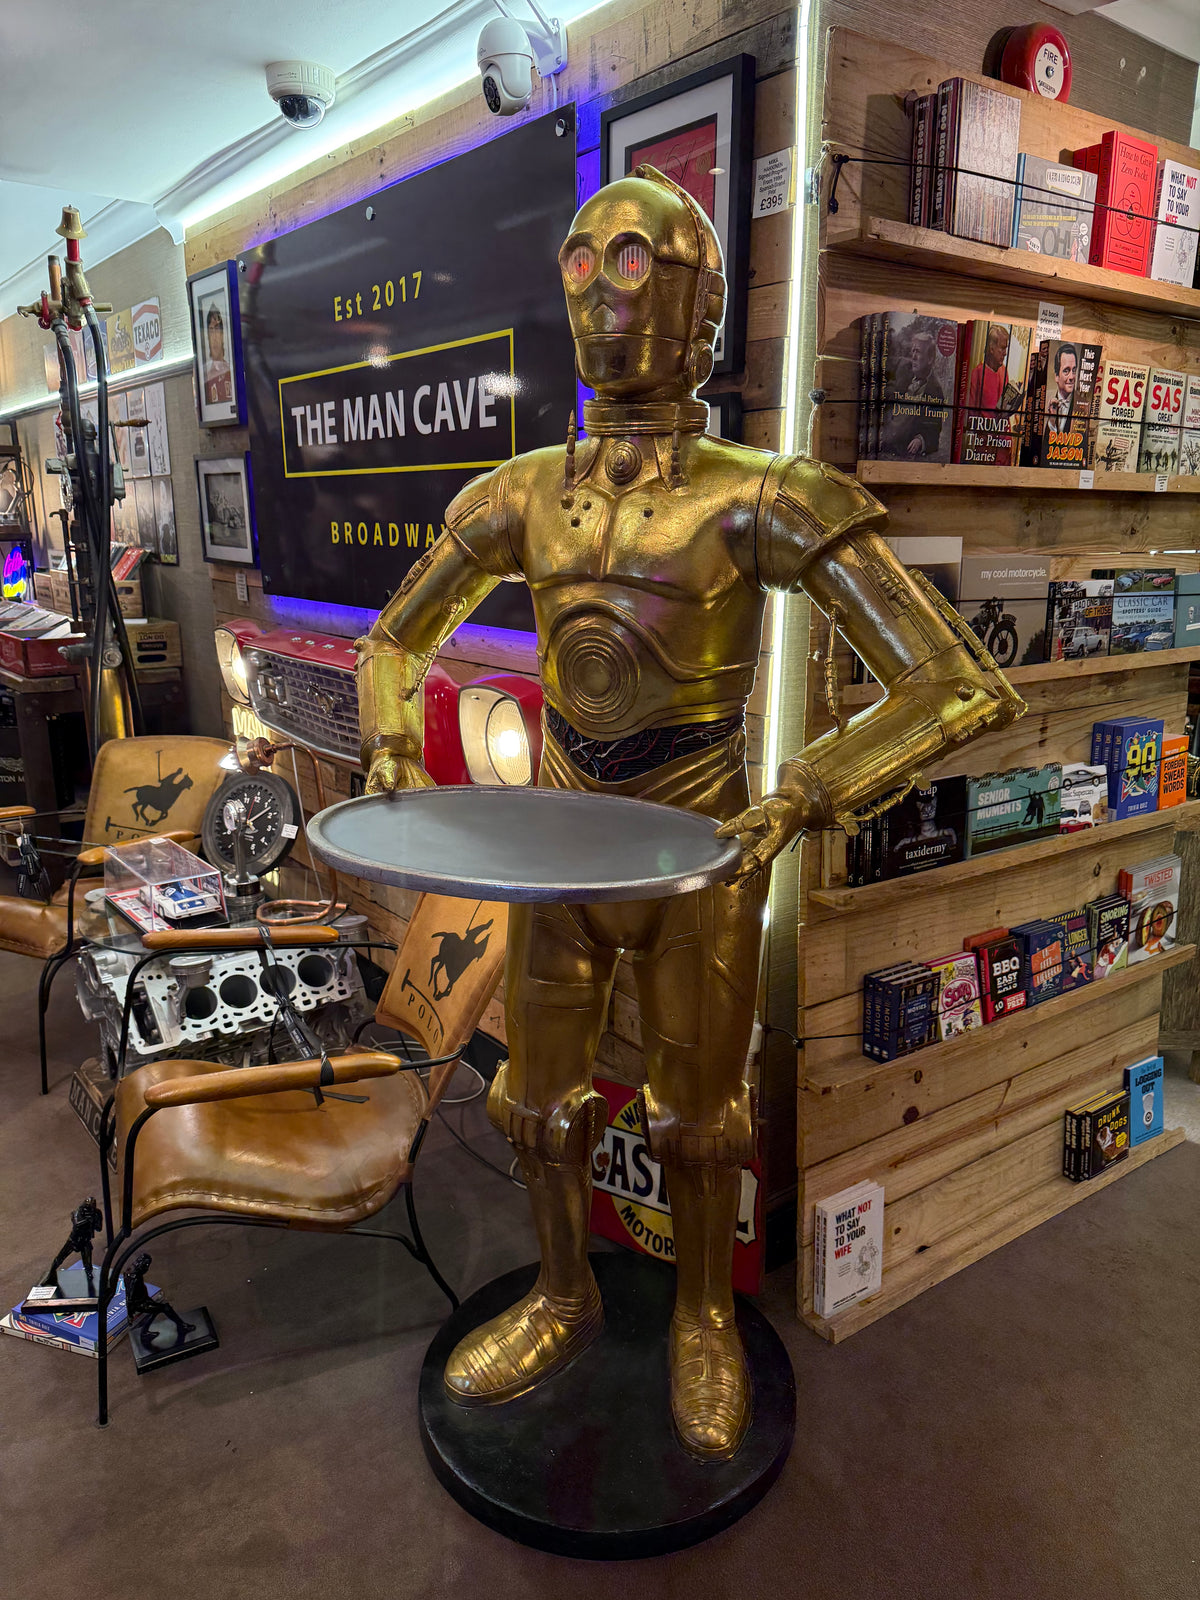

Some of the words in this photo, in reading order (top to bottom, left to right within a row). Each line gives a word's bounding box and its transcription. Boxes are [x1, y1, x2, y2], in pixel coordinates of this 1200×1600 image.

[1043, 48, 1058, 65] FIRE
[1120, 146, 1133, 160] How
[1133, 151, 1139, 161] to
[1121, 162, 1134, 176] Zero
[1170, 170, 1186, 186] WHAT
[1185, 174, 1198, 190] NOT
[936, 173, 944, 210] COVERS
[1169, 185, 1176, 198] TO
[1176, 186, 1187, 202] SAY
[760, 194, 783, 211] £395
[912, 188, 922, 225] COVERS
[1167, 199, 1174, 212] TO
[1175, 201, 1190, 217] YOUR
[334, 292, 362, 322] Est
[372, 270, 422, 311] 2017
[134, 318, 160, 345] TEXACO
[1084, 348, 1096, 360] This
[1080, 358, 1095, 371] Time
[1080, 370, 1093, 382] Next
[1109, 367, 1130, 378] Damien
[1131, 370, 1146, 380] Lewis
[1152, 374, 1171, 384] Damien
[1172, 378, 1184, 387] Lewis
[1079, 382, 1091, 393] Year
[1105, 377, 1144, 408] SAS
[892, 392, 903, 400] The
[904, 393, 927, 402] Beautiful
[927, 395, 943, 404] Poetry
[1150, 384, 1182, 413] SAS
[291, 401, 338, 447] THE
[343, 390, 406, 442] MAN
[413, 375, 497, 435] CAVE
[892, 404, 921, 416] Donald
[922, 406, 949, 422] Trump
[1111, 406, 1134, 419] FORGED
[1158, 412, 1174, 422] GREAT
[968, 416, 1010, 432] TRUMP:
[1110, 418, 1117, 428] IN
[1117, 420, 1134, 430] HELL
[1147, 422, 1170, 434] ESCAPES
[966, 433, 984, 446] The
[986, 434, 1012, 448] Prison
[1048, 431, 1084, 447] DAVID
[966, 448, 996, 462] Diaries
[1046, 446, 1084, 462] JASON
[330, 521, 446, 548] BROADWA
[981, 570, 992, 580] my
[992, 568, 1008, 578] cool
[1008, 567, 1047, 578] motorcycle.
[1117, 598, 1150, 608] CLASSIC
[1152, 596, 1168, 606] CAR
[1085, 608, 1094, 617] OF
[1094, 606, 1112, 616] THOSE
[1164, 758, 1186, 772] FOREIGN
[1163, 768, 1185, 784] SWEAR
[1162, 780, 1185, 794] WORDS
[244, 796, 250, 804] 11
[977, 788, 1010, 806] SENIOR
[976, 800, 1022, 820] MOMENTS
[1127, 803, 1140, 812] TRIVIA
[260, 836, 266, 844] 4
[905, 842, 948, 860] taxidermy
[1144, 868, 1174, 887] TWISTED
[1100, 904, 1129, 924] SNORING
[1068, 928, 1088, 945] LONGER
[992, 956, 1020, 976] BBQ
[996, 972, 1018, 986] EASY
[907, 1003, 927, 1014] MOVIES
[994, 1001, 1004, 1012] 10
[1006, 998, 1025, 1010] PREP
[408, 993, 439, 1044] POLO
[864, 1000, 872, 1034] MOVIES
[1135, 1068, 1162, 1087] LOGGING
[1142, 1081, 1155, 1094] OUT
[1098, 1104, 1121, 1128] DRUNK
[1109, 1116, 1128, 1131] DOGS
[836, 1206, 856, 1224] WHAT
[857, 1200, 872, 1215] NOT
[835, 1225, 845, 1236] TO
[846, 1216, 860, 1231] SAY
[834, 1237, 844, 1248] TO
[846, 1226, 866, 1242] YOUR
[834, 1242, 852, 1260] WIFE
